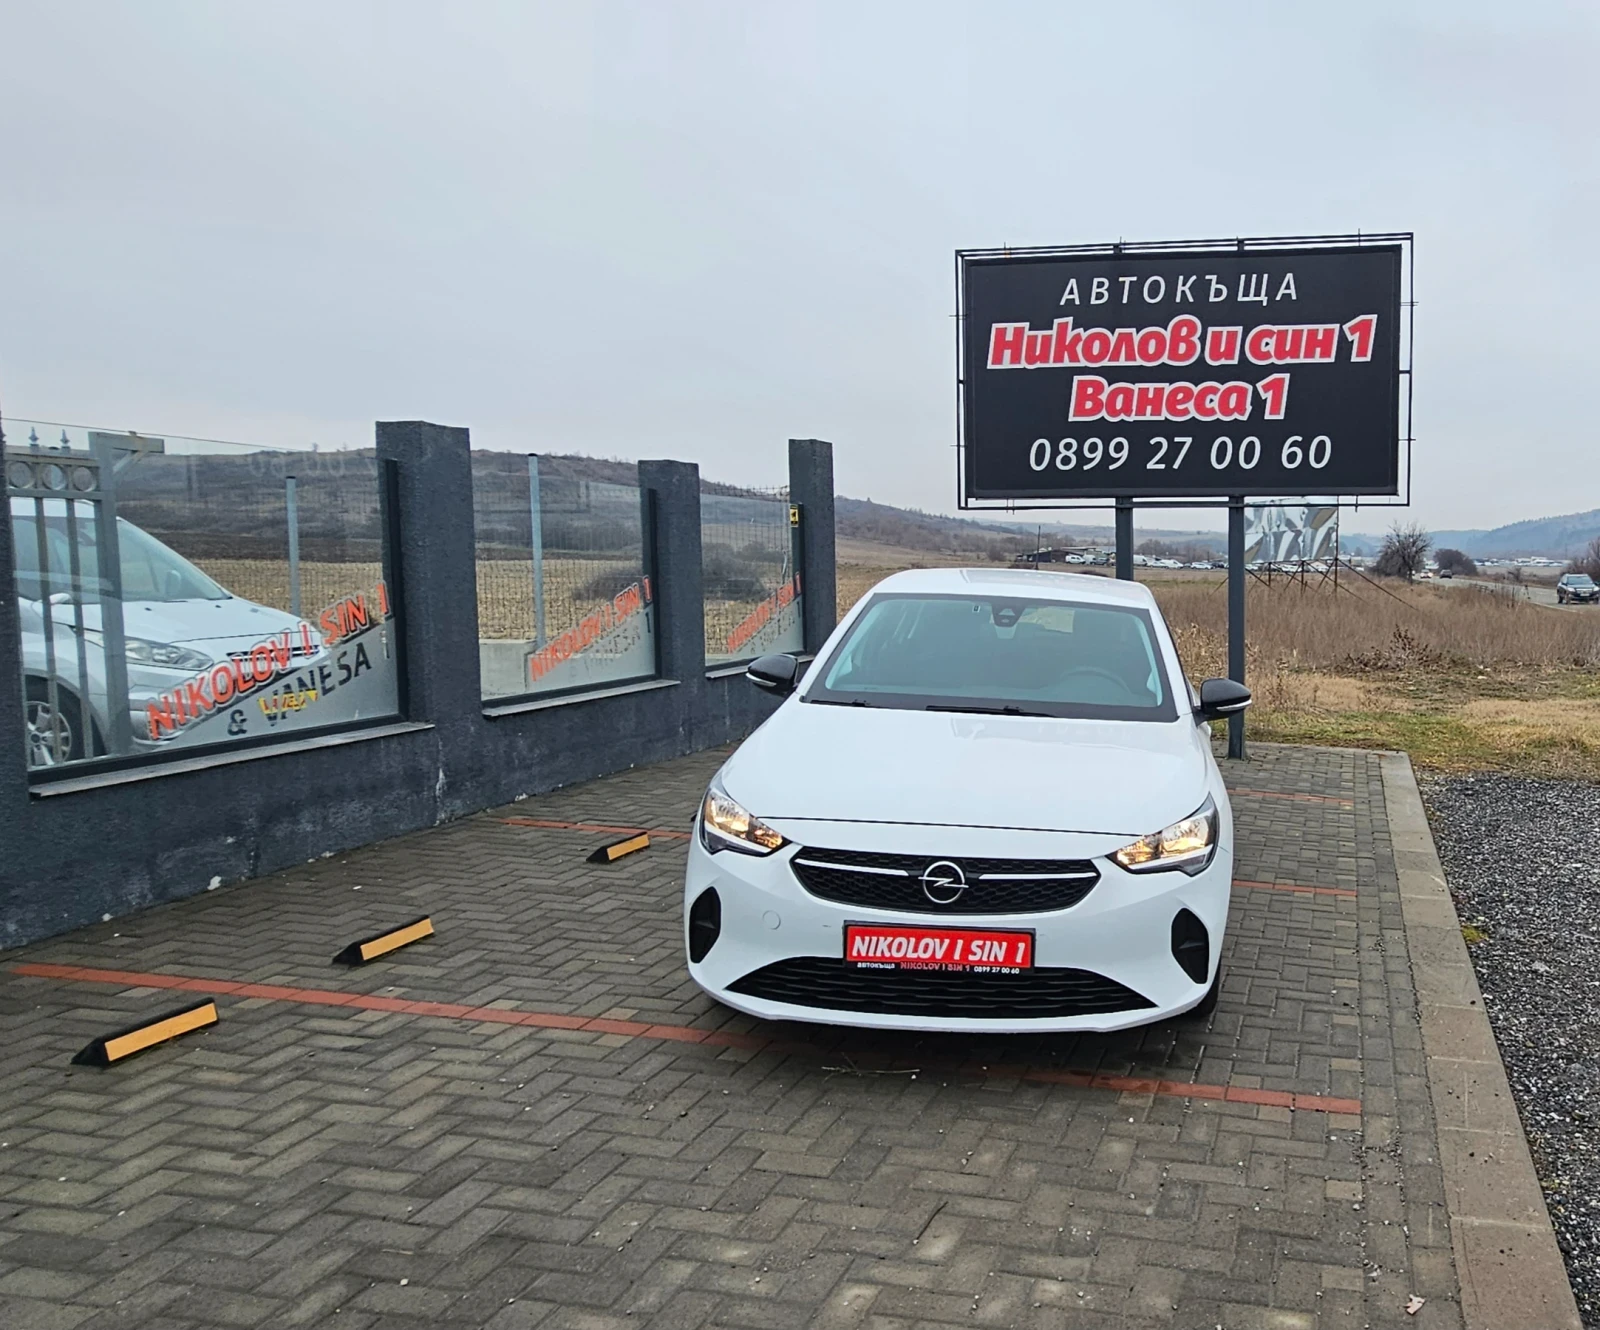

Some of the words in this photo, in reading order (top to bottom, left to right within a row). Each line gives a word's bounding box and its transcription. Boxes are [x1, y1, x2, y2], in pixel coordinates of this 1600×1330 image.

[1059, 272, 1298, 306] АВТОКЪЩА
[987, 314, 1201, 369] Николов
[1204, 326, 1243, 366] и
[1245, 324, 1340, 366] син
[1342, 314, 1377, 362] 1
[1068, 374, 1252, 421] Ванеса
[1256, 373, 1290, 420] 1
[1029, 437, 1130, 471] 0899
[1146, 436, 1193, 470] 27
[1210, 436, 1261, 470] 00
[1281, 435, 1332, 469] 60
[147, 630, 292, 740] NIKOLOV
[319, 592, 369, 648] SIN
[227, 709, 247, 736] &
[852, 935, 950, 960] NIKOLOV
[953, 938, 964, 961] I
[968, 939, 1008, 963] SIN
[1015, 942, 1026, 964] 1
[900, 962, 940, 971] NIKOLOV
[974, 965, 991, 973] 0899
